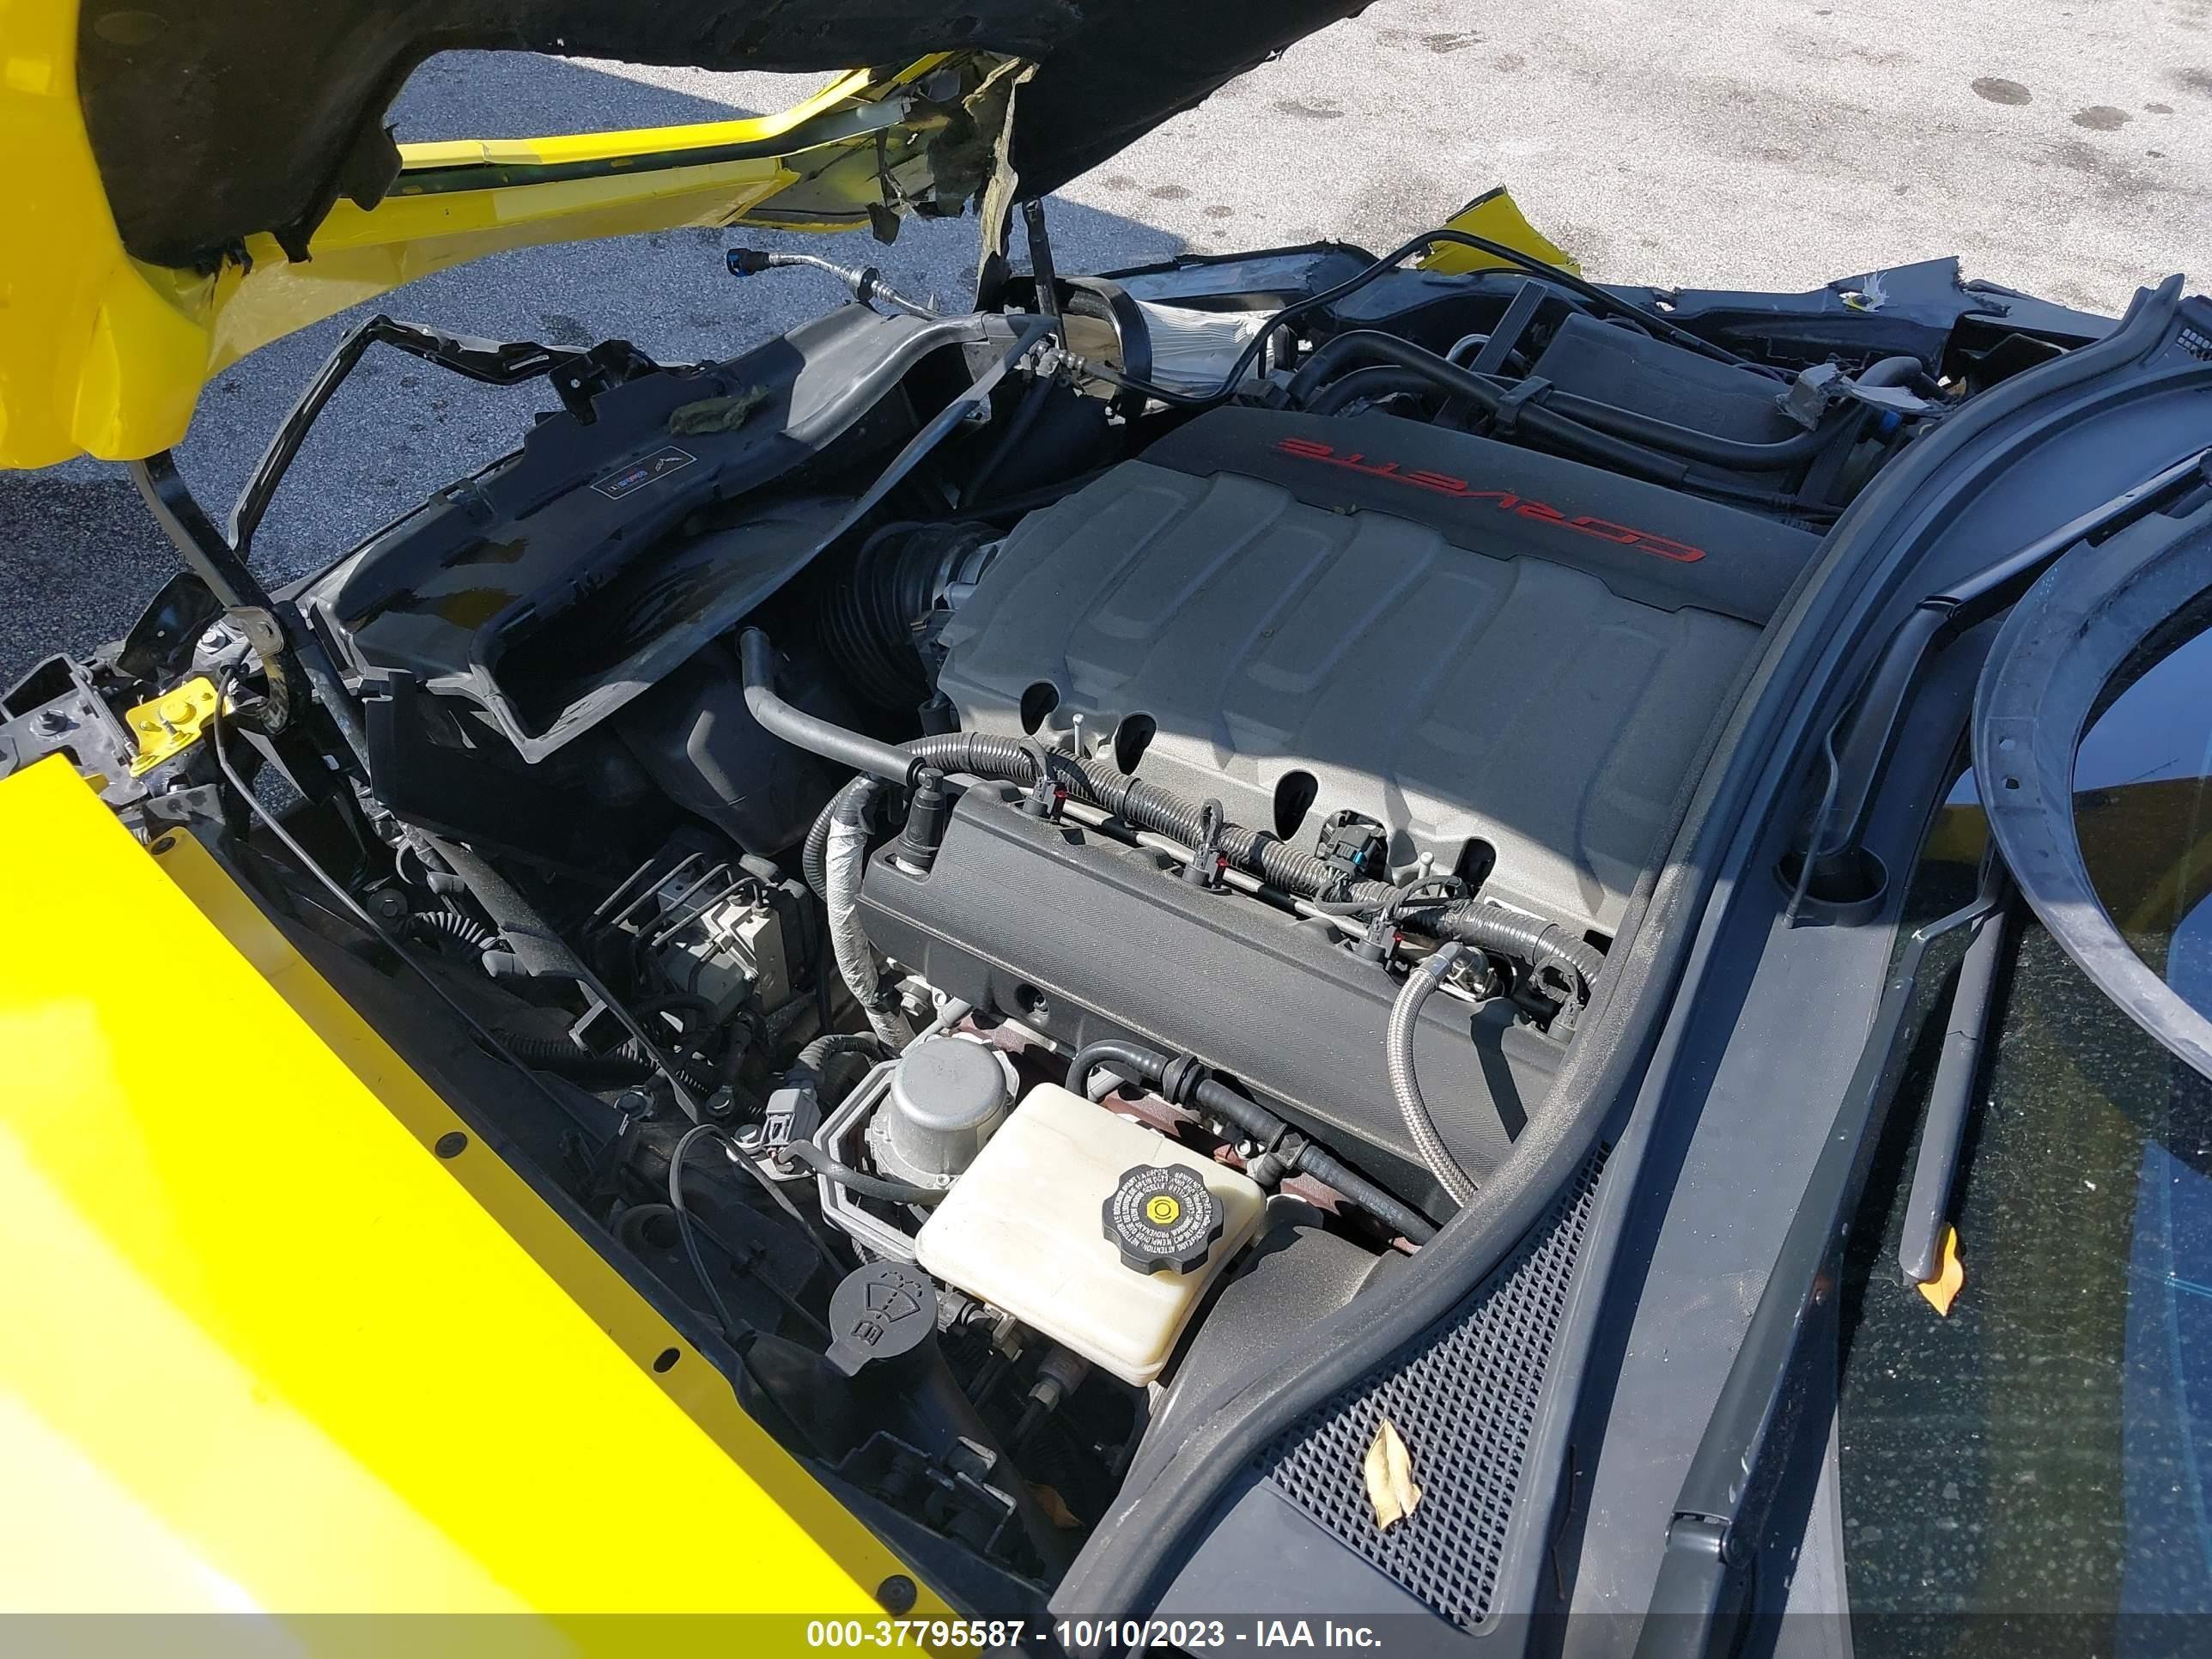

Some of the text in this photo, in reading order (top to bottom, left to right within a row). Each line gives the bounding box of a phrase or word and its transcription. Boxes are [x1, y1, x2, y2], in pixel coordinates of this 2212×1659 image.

[1277, 438, 1705, 562] CORVETTE
[1167, 1185, 1188, 1200] FILLER
[1116, 1222, 1140, 1247] NETTOYER
[1126, 1221, 1139, 1235] QUE
[1134, 1219, 1170, 1238] PROVENANT
[1173, 1234, 1186, 1244] CAP
